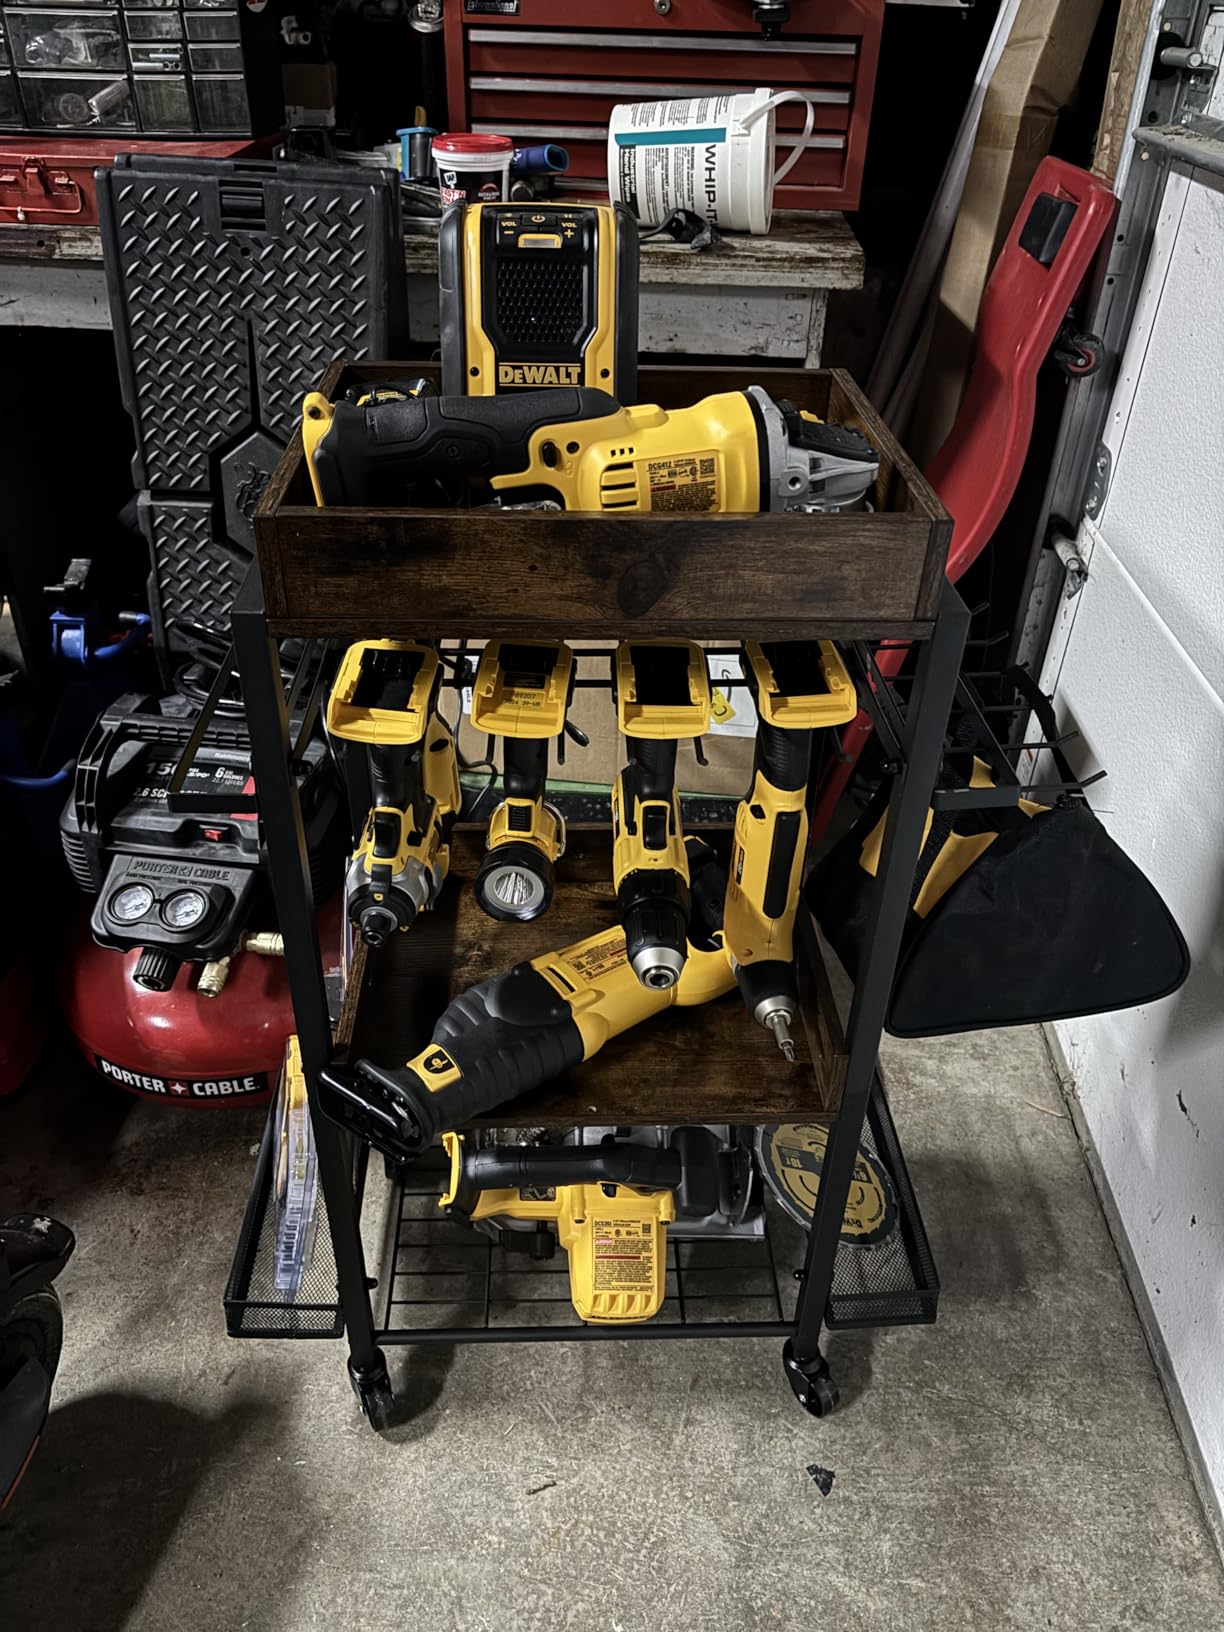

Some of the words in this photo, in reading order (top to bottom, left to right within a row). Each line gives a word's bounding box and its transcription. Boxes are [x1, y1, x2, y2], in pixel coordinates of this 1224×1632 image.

[498, 365, 581, 384] DEWALT
[215, 767, 226, 778] 6
[133, 861, 179, 875] PORTER
[194, 868, 230, 881] CABLE
[101, 1059, 166, 1093] PORTER
[193, 1076, 256, 1096] CABLE
